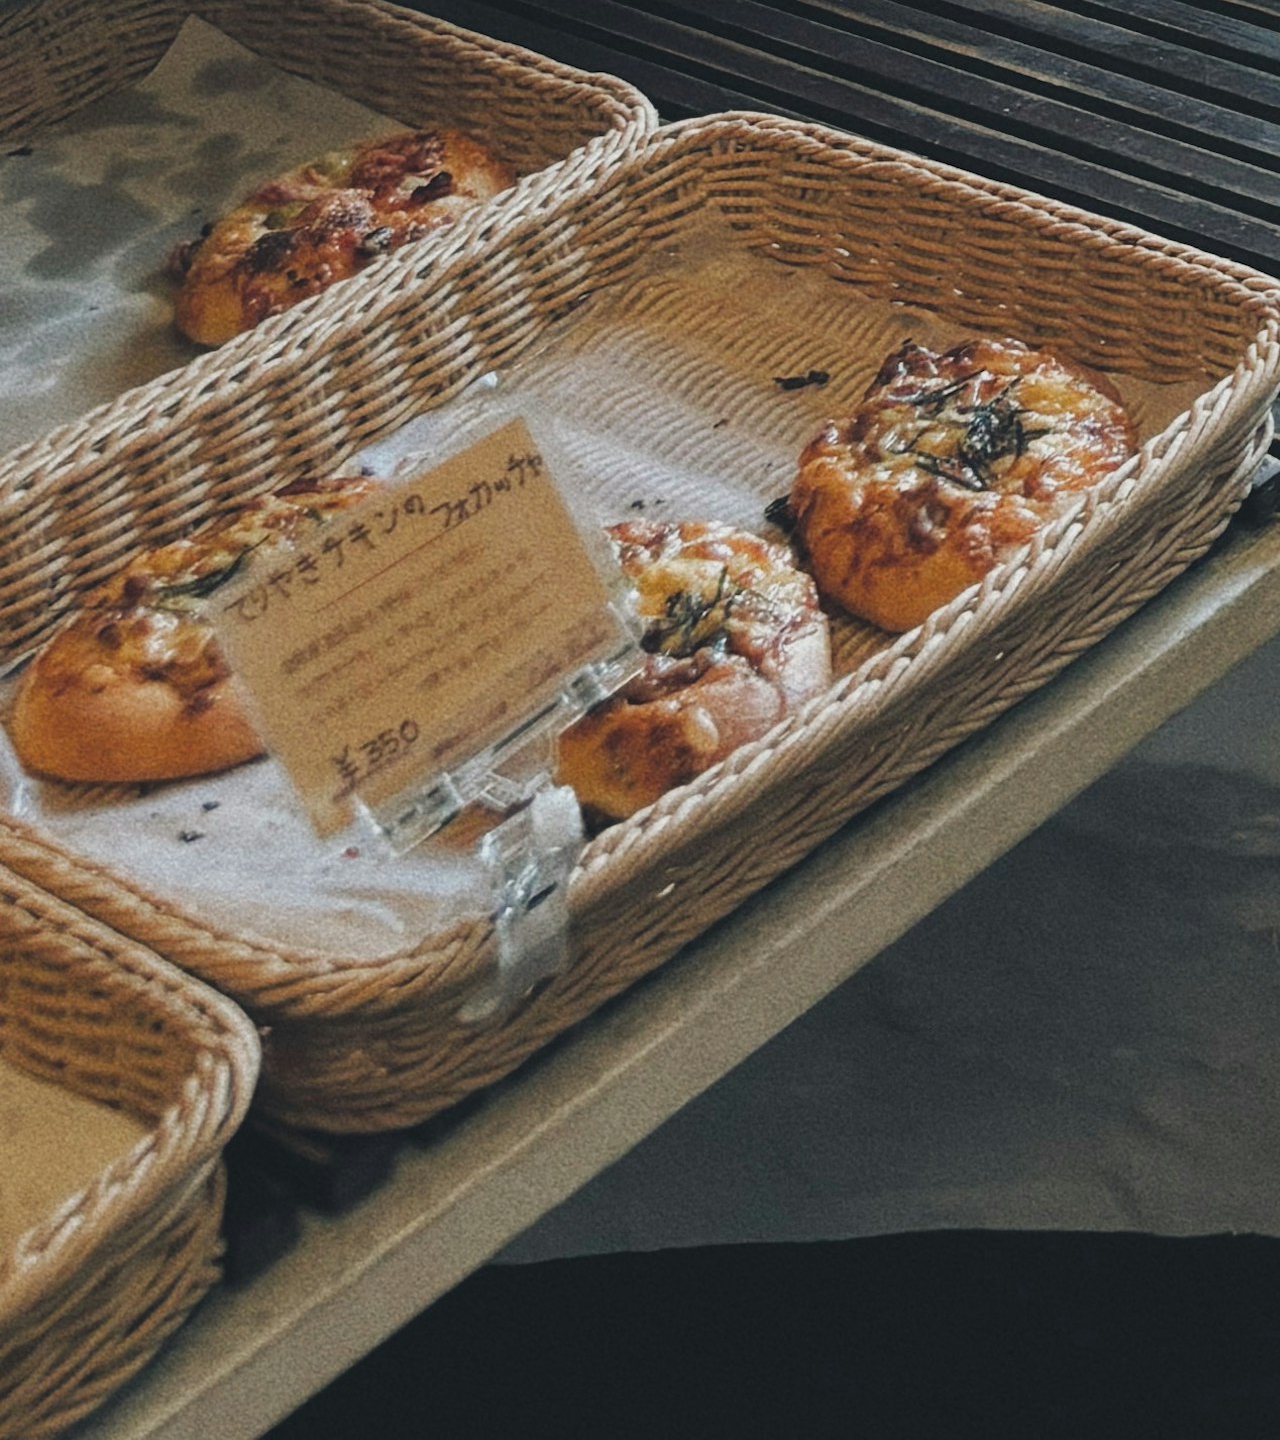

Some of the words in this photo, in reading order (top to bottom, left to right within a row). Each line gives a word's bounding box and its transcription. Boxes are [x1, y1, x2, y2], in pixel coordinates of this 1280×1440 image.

[221, 492, 429, 622] てりやきチキンの
[330, 718, 420, 781] ¥350
